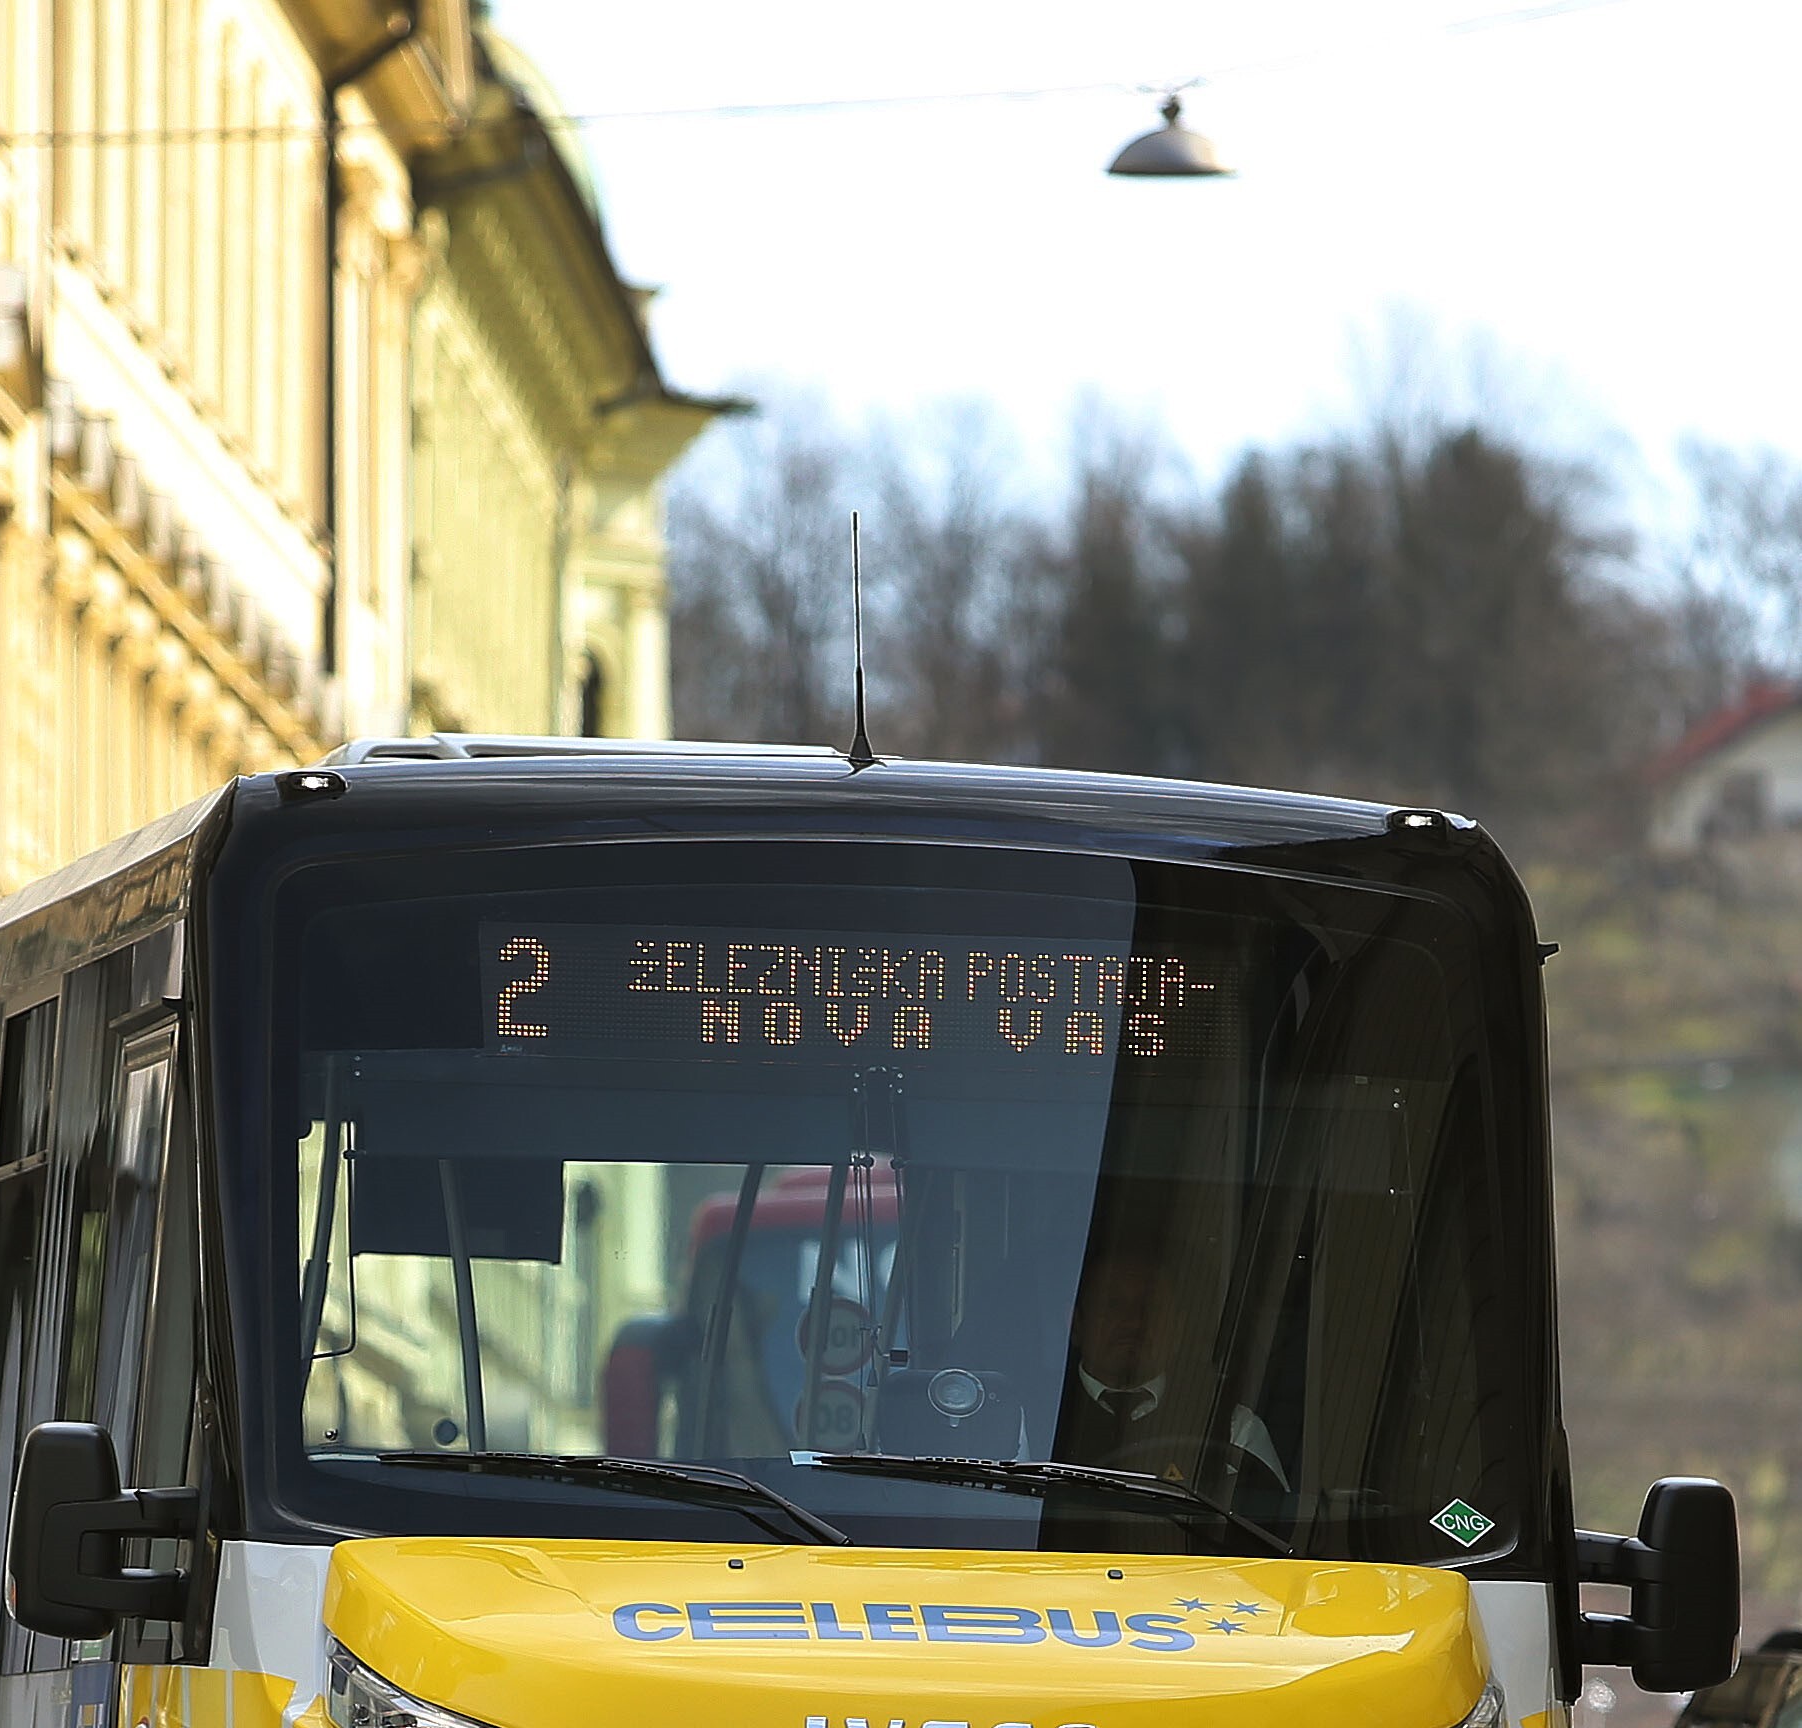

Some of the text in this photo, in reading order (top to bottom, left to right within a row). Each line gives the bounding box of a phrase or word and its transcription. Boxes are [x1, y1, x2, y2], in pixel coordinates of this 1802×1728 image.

[497, 936, 550, 1038] 2
[628, 939, 1216, 1007] ŽELEZNIŠKA POSTAJA-
[700, 1000, 1165, 1056] NOVA VAS
[1441, 1513, 1485, 1531] CNG
[611, 1600, 1198, 1652] CELEBUS
